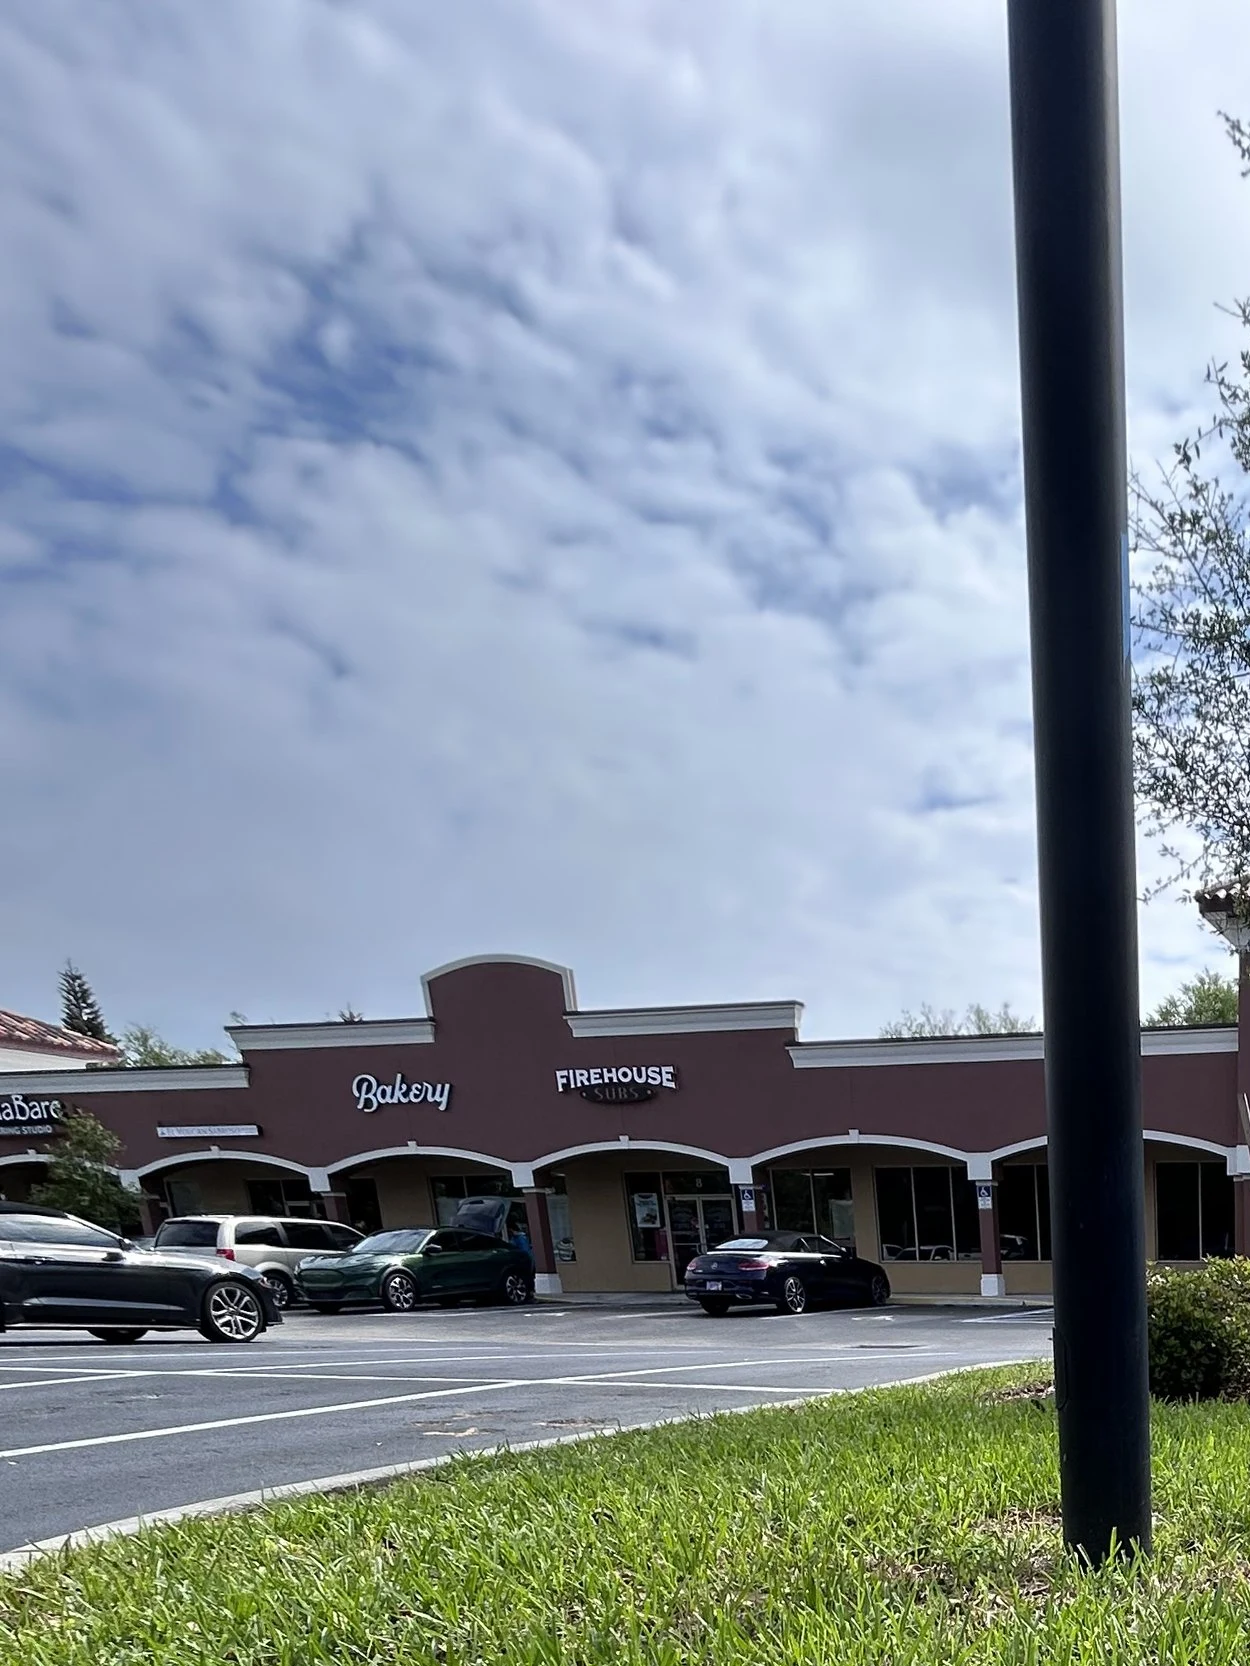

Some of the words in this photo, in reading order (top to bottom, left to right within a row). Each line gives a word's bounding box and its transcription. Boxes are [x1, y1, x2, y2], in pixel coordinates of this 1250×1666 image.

[555, 1066, 676, 1092] FIREHOUSE
[352, 1073, 450, 1112] Bakery
[594, 1087, 639, 1101] SUBS
[22, 1124, 53, 1135] STUDIO
